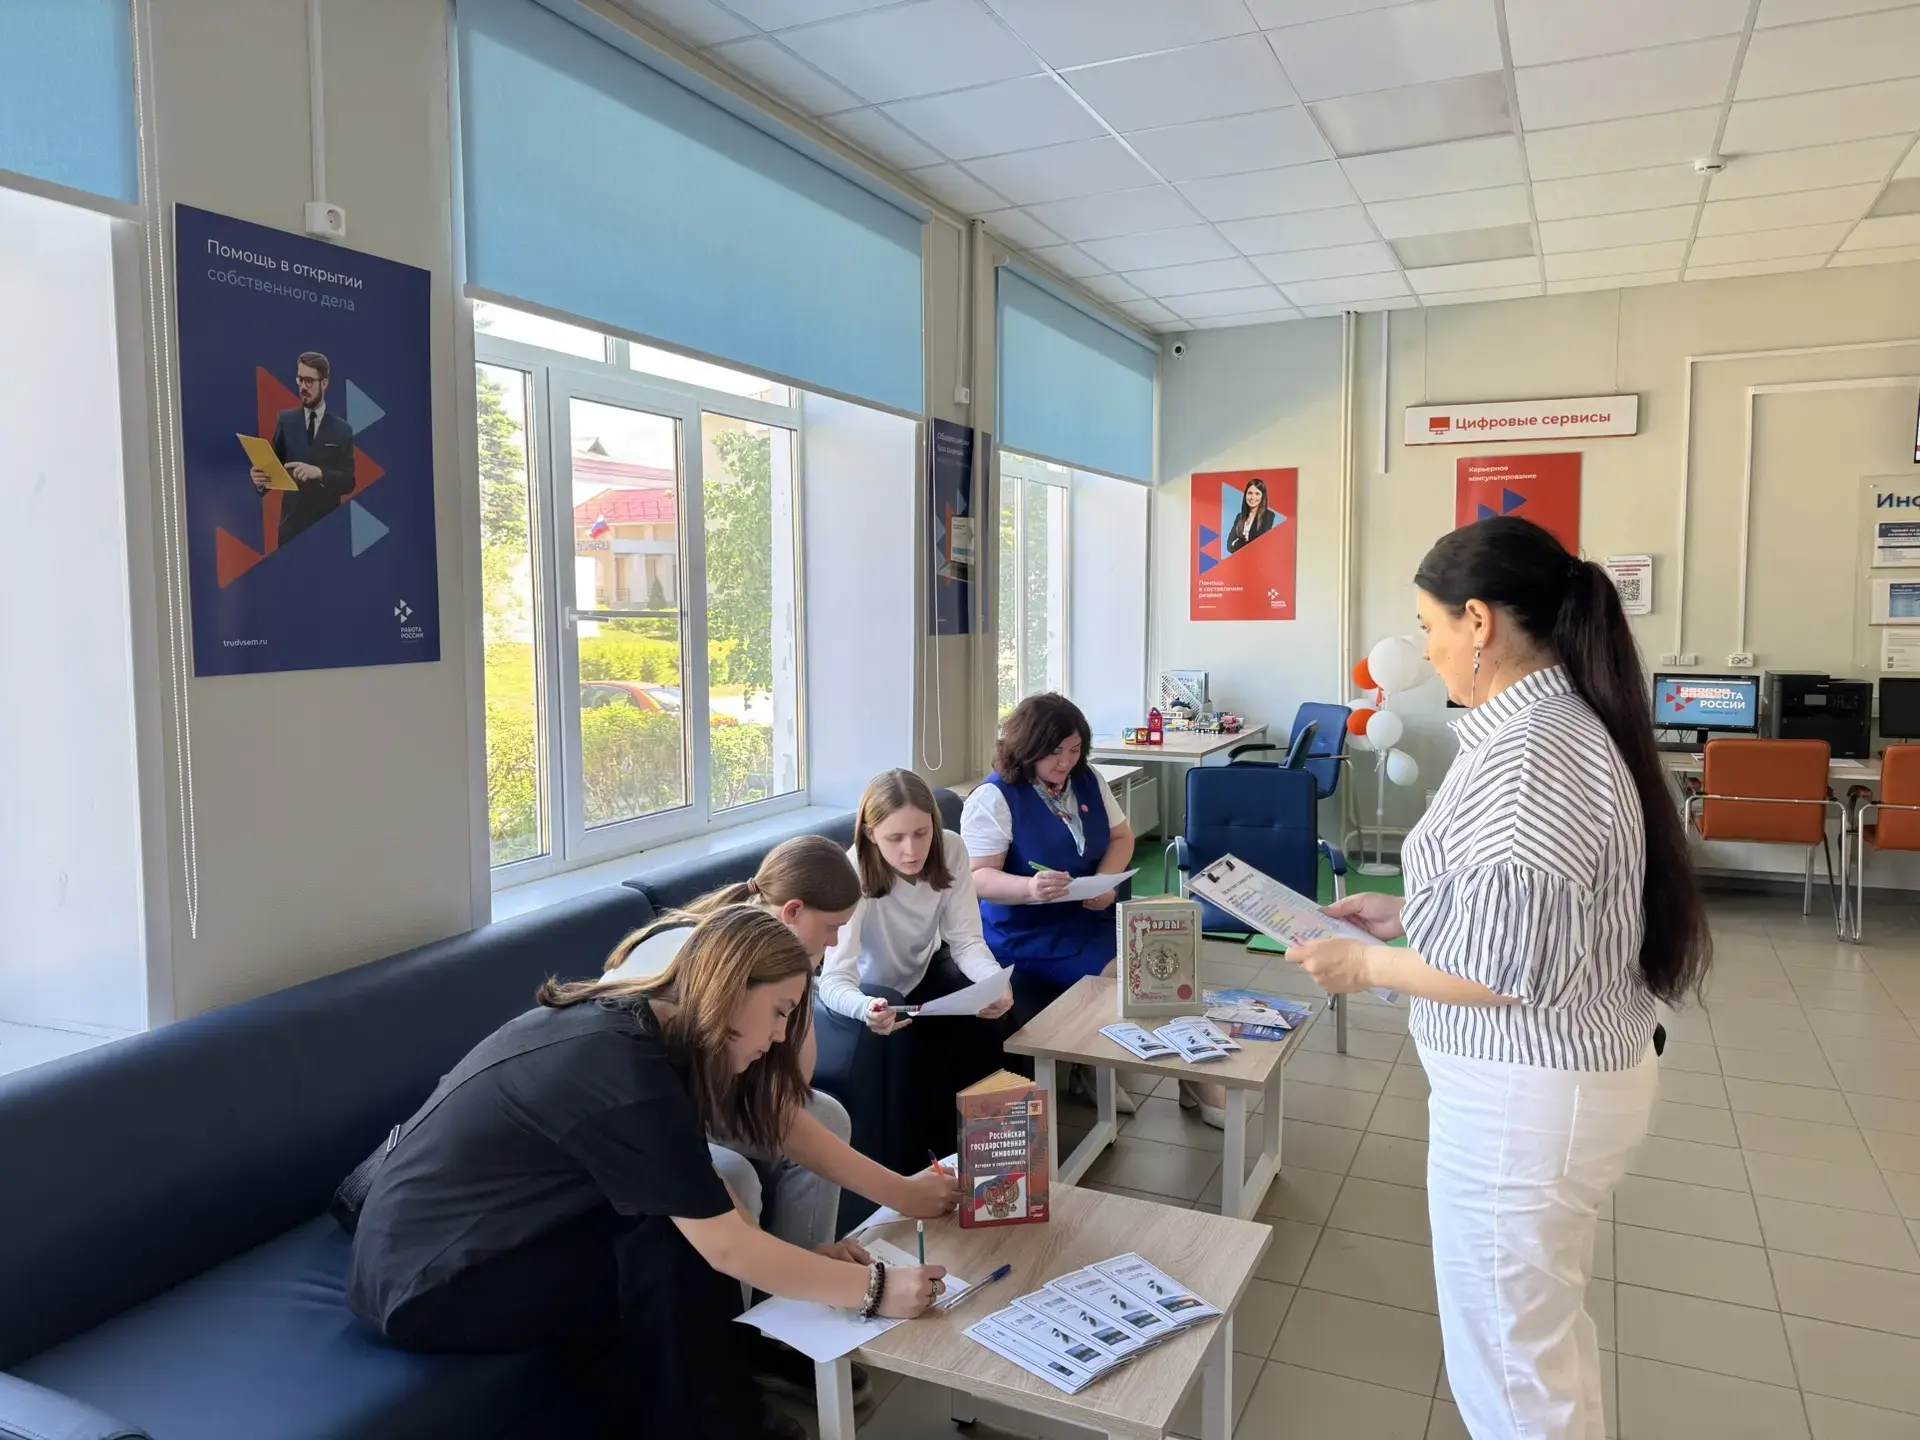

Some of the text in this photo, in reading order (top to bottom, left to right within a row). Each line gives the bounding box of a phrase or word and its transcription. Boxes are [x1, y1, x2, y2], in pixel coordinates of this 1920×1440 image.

[207, 239, 363, 290] Помощь в открытии
[207, 267, 355, 311] собственного дела
[1455, 412, 1611, 430] Цифровые сервисы
[223, 638, 268, 647] trudvsem.ru
[1700, 699, 1746, 709] РОССИИ
[988, 1130, 1026, 1140] Российская
[970, 1139, 1027, 1151] государственная
[991, 1148, 1027, 1158] символика
